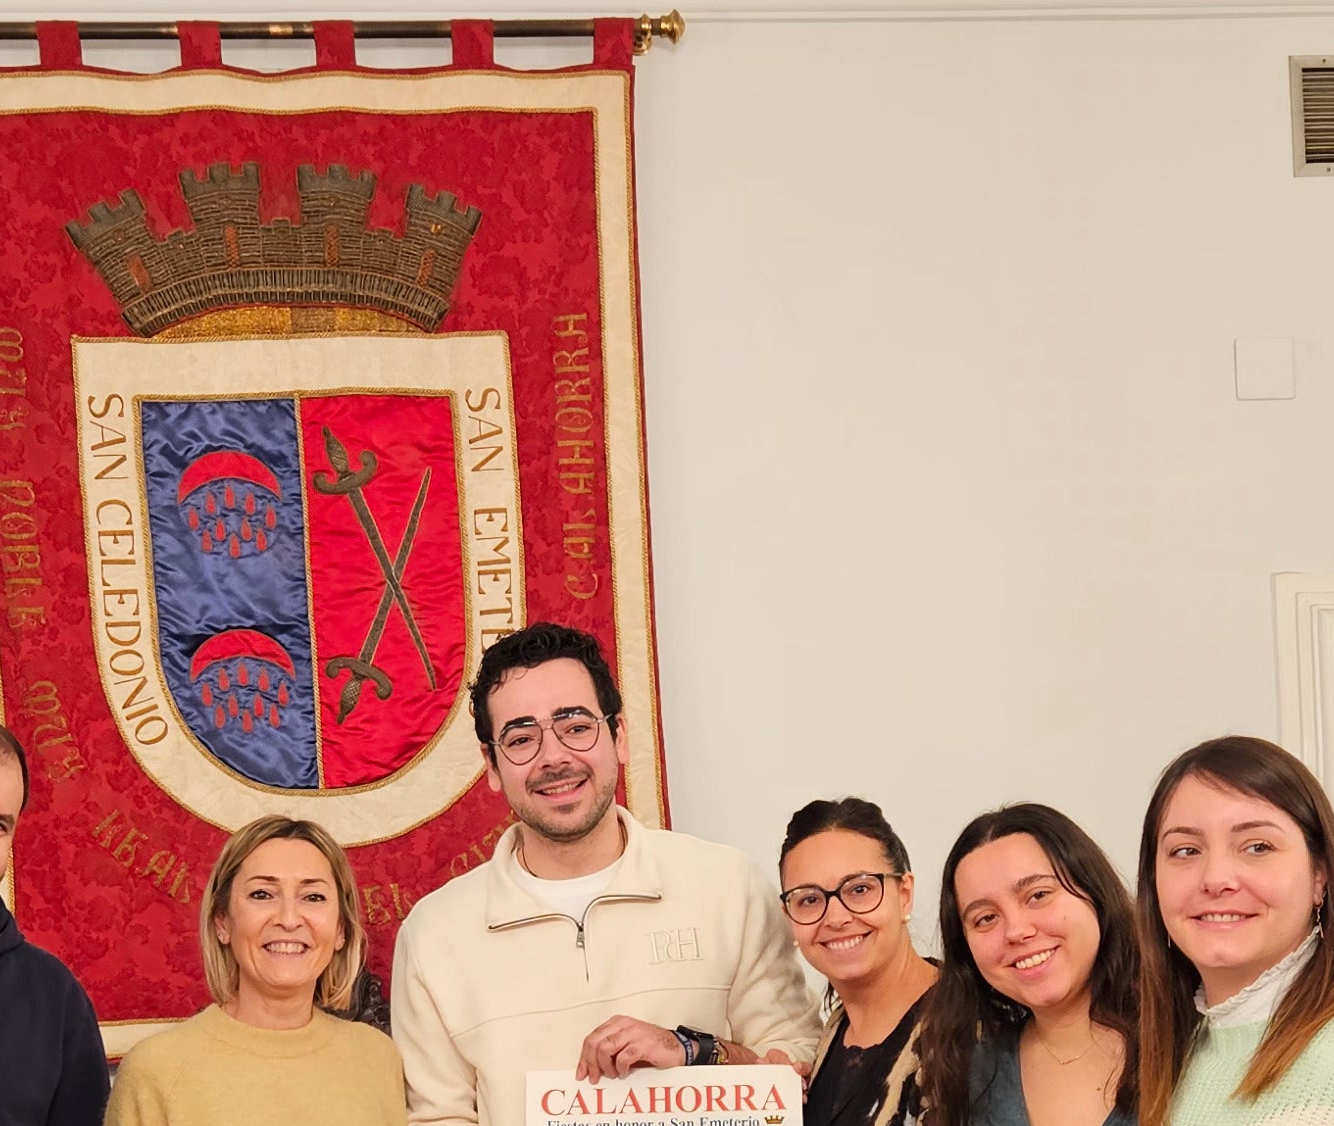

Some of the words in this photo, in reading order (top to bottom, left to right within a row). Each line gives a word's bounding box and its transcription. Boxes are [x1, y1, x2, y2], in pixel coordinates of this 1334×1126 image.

[88, 393, 128, 480] SAN
[465, 387, 504, 472] SAN
[95, 499, 168, 746] CELEDONIO
[473, 507, 515, 654] EMETE
[541, 1084, 787, 1116] CALAHORRA
